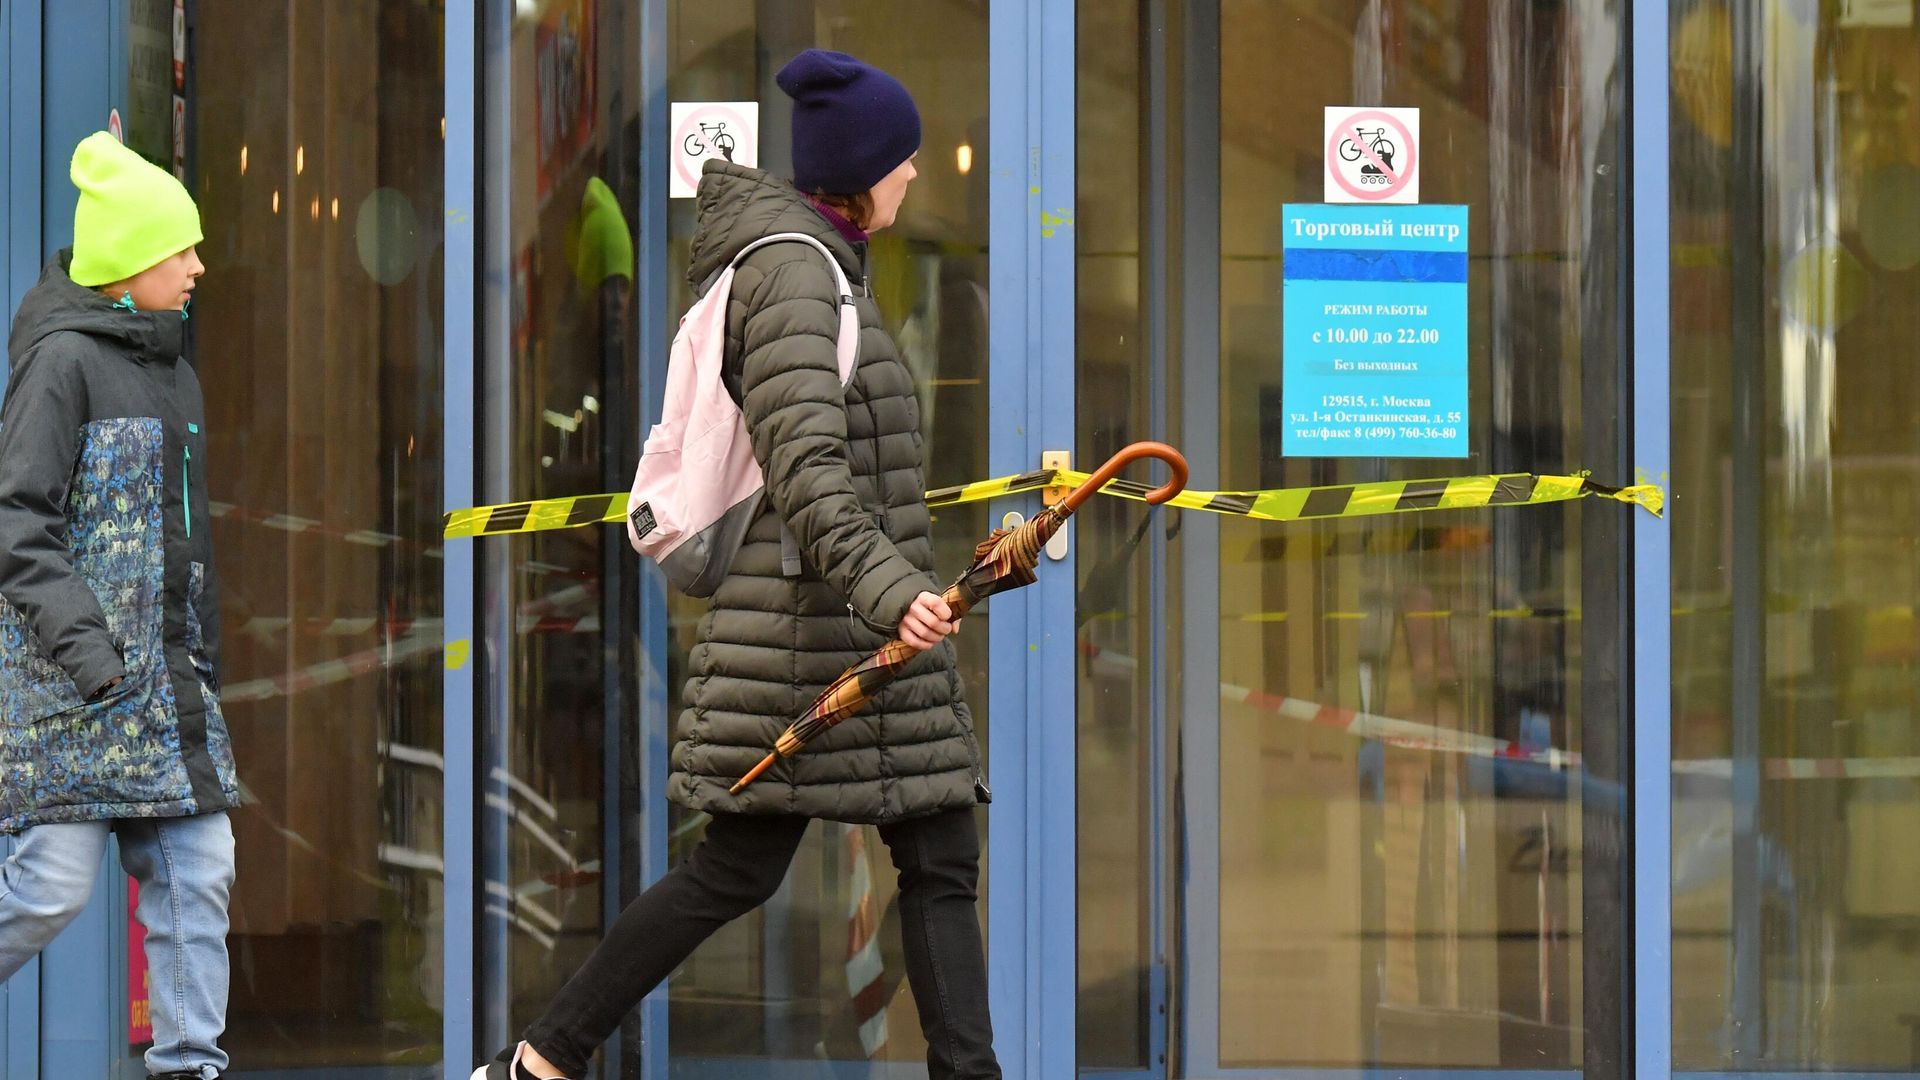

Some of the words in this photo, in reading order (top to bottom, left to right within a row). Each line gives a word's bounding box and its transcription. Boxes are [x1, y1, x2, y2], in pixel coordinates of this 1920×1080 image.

[1290, 218, 1394, 242] Торговый
[1400, 222, 1460, 243] центр
[1324, 304, 1373, 316] РЕЖИМ
[1376, 304, 1428, 316] РАБОТЫ
[1312, 331, 1322, 344] с
[1327, 327, 1369, 344] 10.00
[1372, 331, 1393, 346] до
[1396, 328, 1440, 344] 22.00
[1334, 358, 1355, 371] Без
[1357, 361, 1418, 372] выходных
[1322, 394, 1368, 409] 129515,
[1370, 398, 1379, 407] г.
[1383, 395, 1431, 408] Москва
[1290, 413, 1309, 425] ул.
[1313, 411, 1332, 423] 1-я
[1334, 410, 1431, 424] Останкинская,
[1433, 414, 1444, 425] д.
[1447, 411, 1462, 423] 55
[1296, 426, 1351, 441] тел/факс
[1354, 427, 1362, 438] 8
[1364, 426, 1396, 440] (499)
[1399, 427, 1457, 439] 760-36-80
